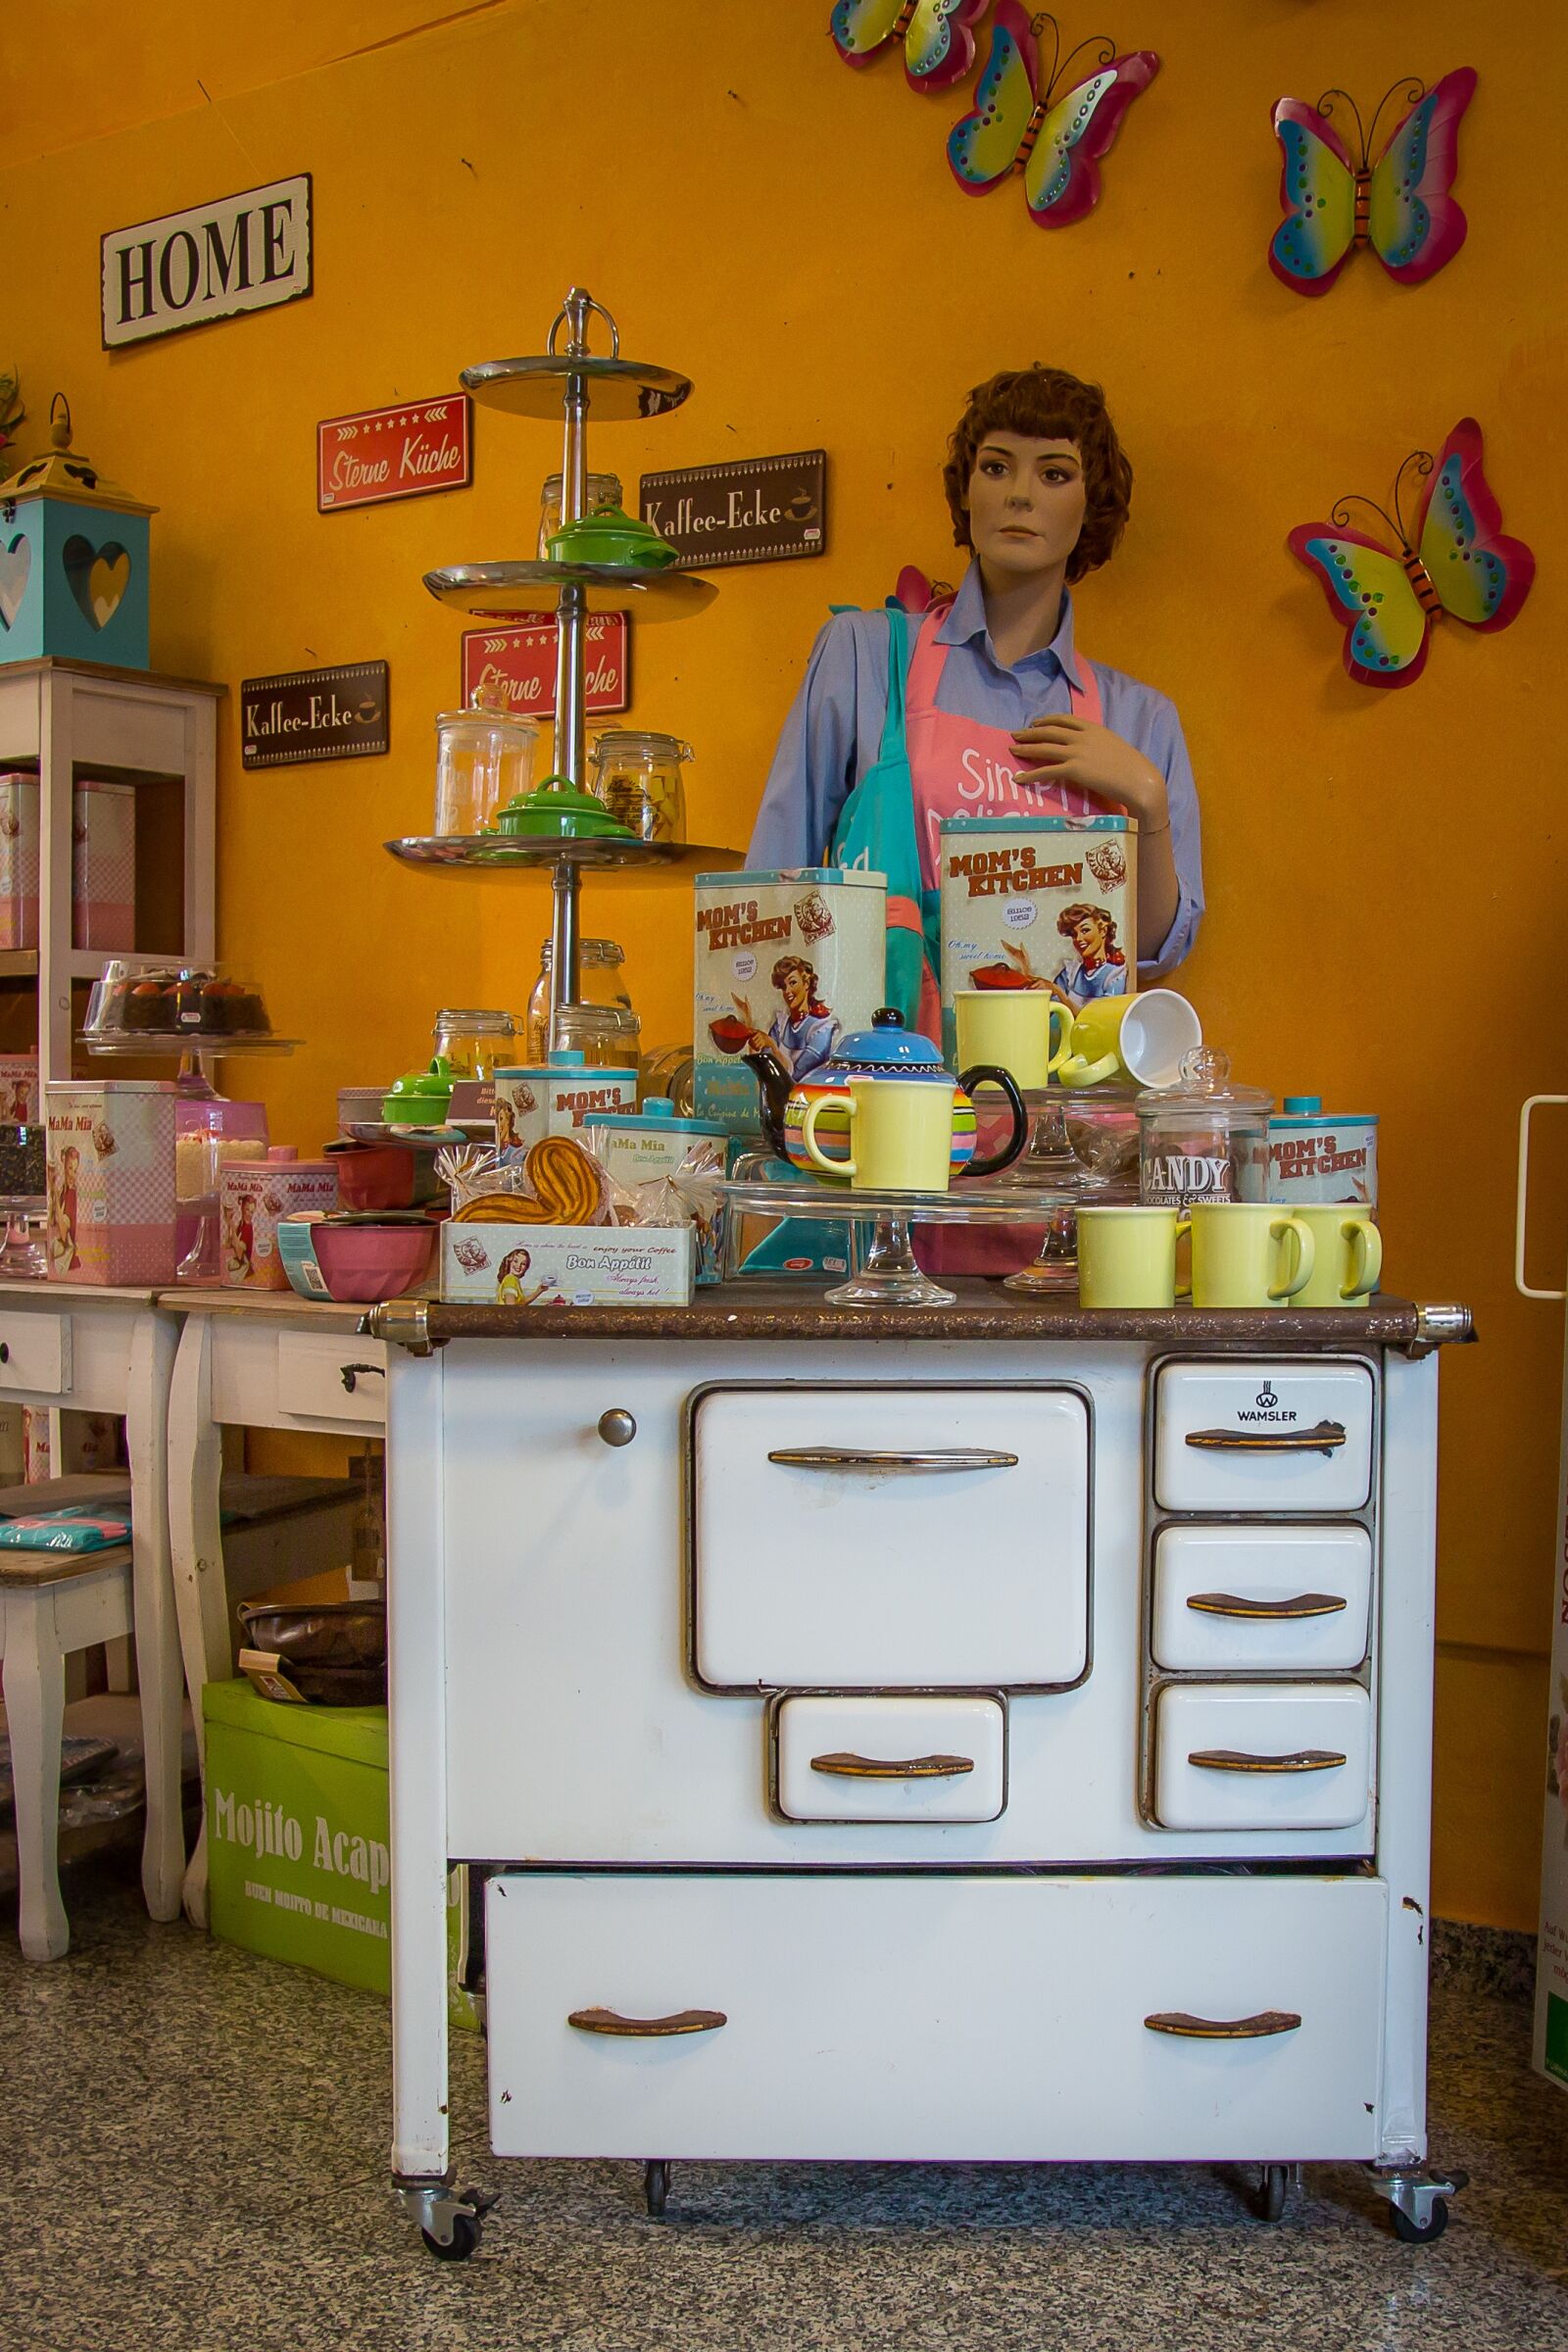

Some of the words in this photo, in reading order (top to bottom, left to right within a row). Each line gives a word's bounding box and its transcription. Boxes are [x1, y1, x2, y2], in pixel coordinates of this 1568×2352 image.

[115, 199, 295, 324] HOME
[328, 450, 390, 491] Sterne
[399, 433, 461, 479] Küche
[645, 489, 782, 539] Kaffee-Ecke
[246, 693, 353, 738] Kaffee-Ecke
[950, 846, 1036, 878] MOM'S
[967, 862, 1084, 898] KITCHEN
[697, 900, 759, 932] MOM'S
[709, 914, 793, 951] KITCHEN
[556, 1087, 621, 1112] MOM'S
[48, 1115, 74, 1131] MaMa
[75, 1115, 93, 1131] Mia
[641, 1139, 665, 1152] Mia
[1268, 1135, 1338, 1163] MOM'S
[1143, 1155, 1231, 1193] CANDY
[1279, 1147, 1367, 1180] KITCHEN
[287, 1183, 315, 1193] MaMa
[565, 1254, 596, 1270] Bon
[597, 1254, 652, 1272] Appétit
[593, 1247, 619, 1255] enjoy
[647, 1247, 677, 1255] Coffee
[1237, 1410, 1298, 1422] WAMSLER
[214, 1788, 303, 1861] Mojito
[313, 1816, 390, 1894] Acap
[244, 1880, 272, 1903] BUEN
[274, 1888, 313, 1916] MOJITO
[314, 1901, 330, 1921] DE
[331, 1906, 389, 1939] MEXICANA
